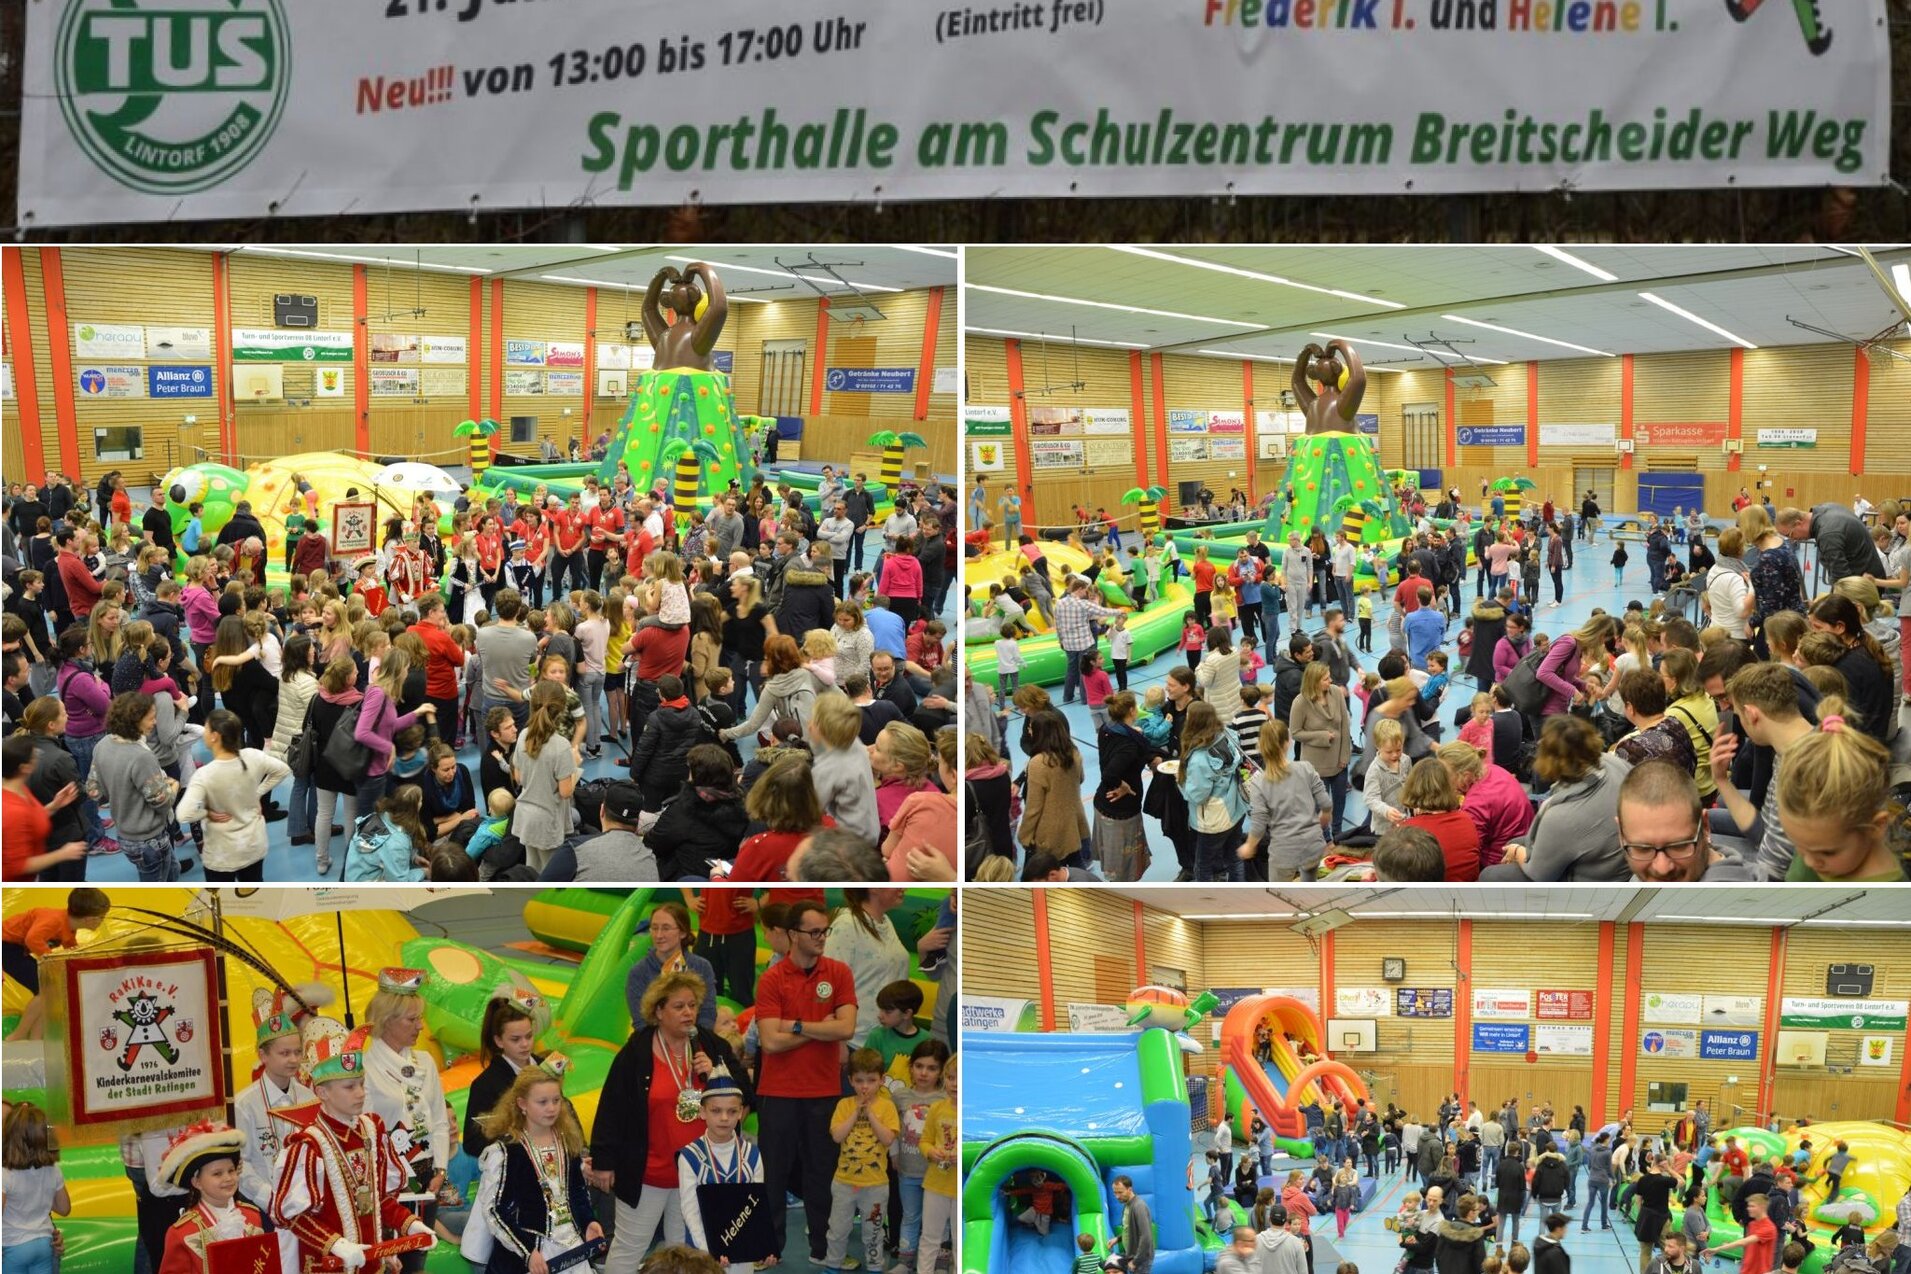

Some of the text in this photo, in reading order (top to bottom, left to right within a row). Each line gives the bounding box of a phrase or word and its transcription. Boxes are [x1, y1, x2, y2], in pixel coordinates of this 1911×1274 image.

[936, 0, 1104, 43] (Eintritt frei)
[1204, 0, 1377, 28] Frederik
[1430, 0, 1497, 31] und
[1509, 0, 1641, 32] Helene
[89, 16, 268, 88] TUS
[355, 16, 867, 114] Neu!!! von 13:00 bis 17:00 Uhr
[124, 113, 251, 168] LINTORF 1908
[581, 107, 1867, 192] Sporthalle am Schulzentrum Breitscheider Weg
[156, 371, 191, 381] Allianz
[156, 384, 206, 393] Peter Braun
[1652, 425, 1703, 438] Sparkasse
[109, 975, 153, 1003] RaKiKa
[1705, 1046, 1751, 1056] Peter Braun
[1707, 1035, 1739, 1045] Allianz
[96, 1066, 202, 1089] Kinderkarnevalskomitee
[140, 1060, 159, 1071] 1976
[107, 1080, 196, 1100] der Stadt Ratingen
[720, 1204, 752, 1247] Helene
